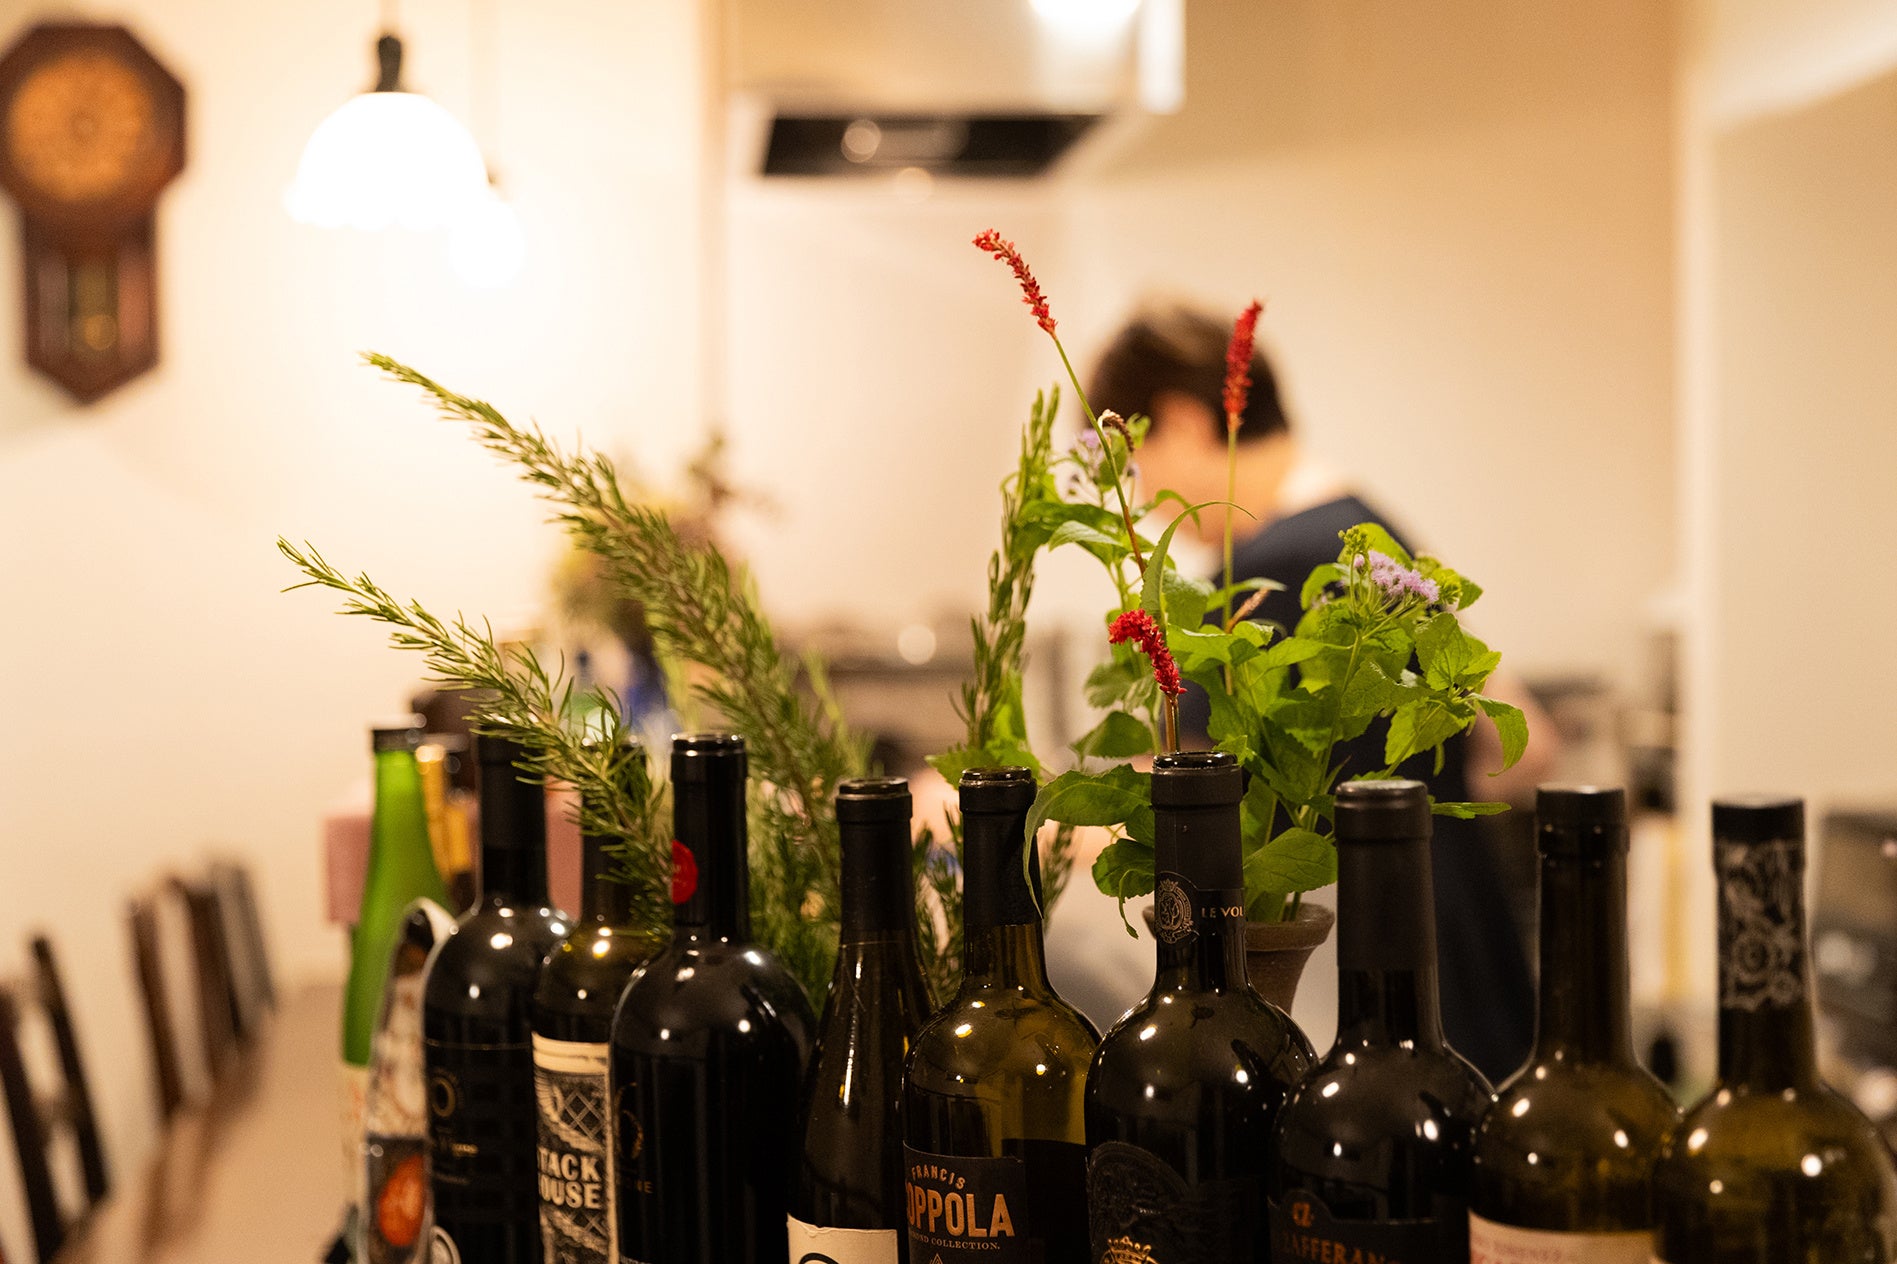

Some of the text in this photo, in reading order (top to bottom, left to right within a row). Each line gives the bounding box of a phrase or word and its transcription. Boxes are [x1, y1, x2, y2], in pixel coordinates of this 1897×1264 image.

[1201, 907, 1216, 918] LE
[536, 1146, 601, 1181] TACK
[911, 1164, 965, 1189] FRANCIS
[537, 1173, 602, 1209] OUSE
